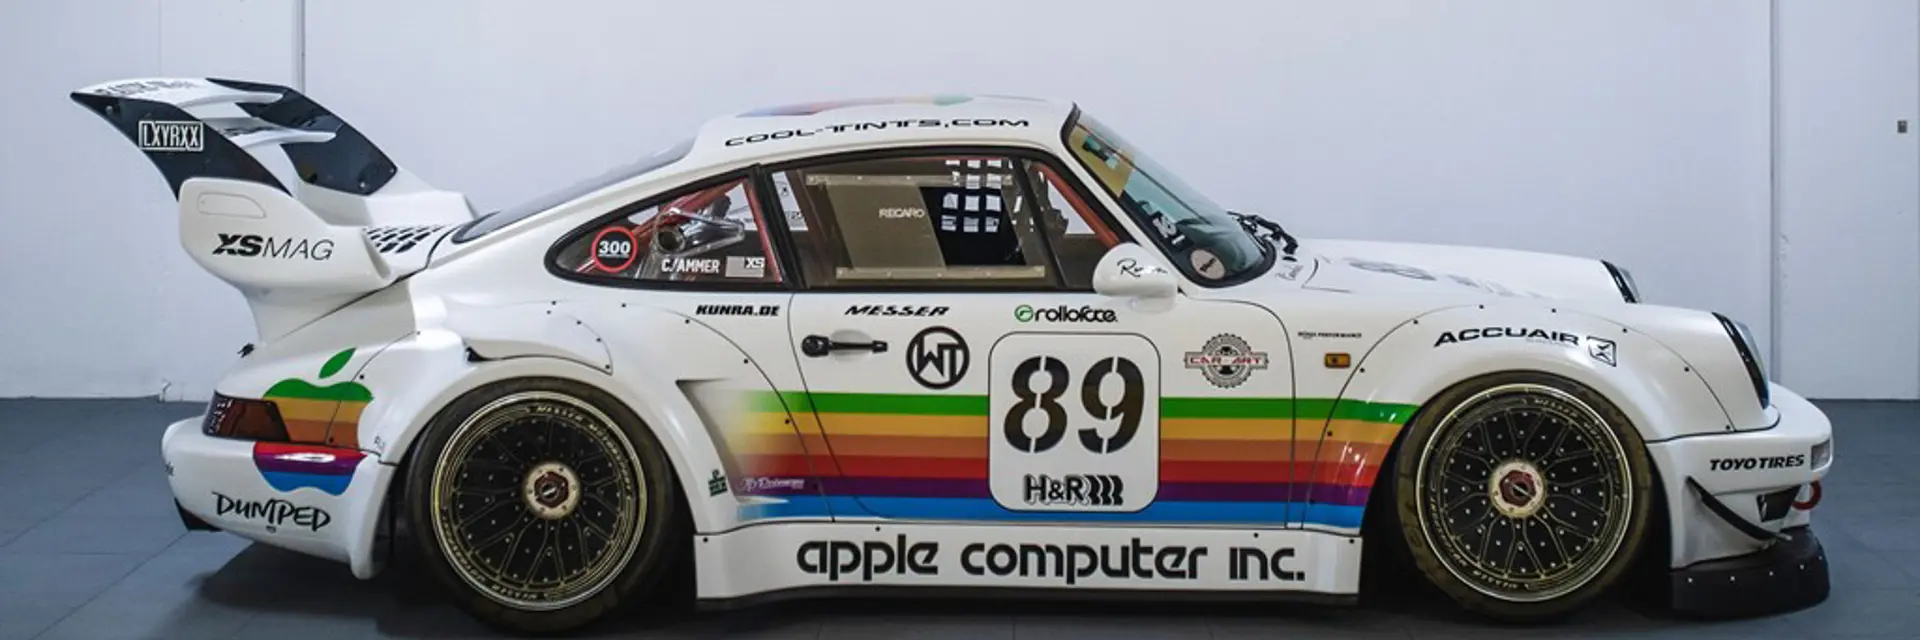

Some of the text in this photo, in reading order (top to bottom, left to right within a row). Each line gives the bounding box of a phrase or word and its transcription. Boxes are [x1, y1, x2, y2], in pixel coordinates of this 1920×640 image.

[142, 121, 201, 148] LXYRXX
[599, 239, 632, 255] 300
[844, 305, 950, 317] MESSER
[1433, 326, 1580, 348] ACCUAIR
[1004, 356, 1145, 454] 89
[1709, 454, 1805, 471] TOYO TIRES
[211, 490, 331, 532] DUMPED
[796, 533, 1305, 585] apple computer inc.
